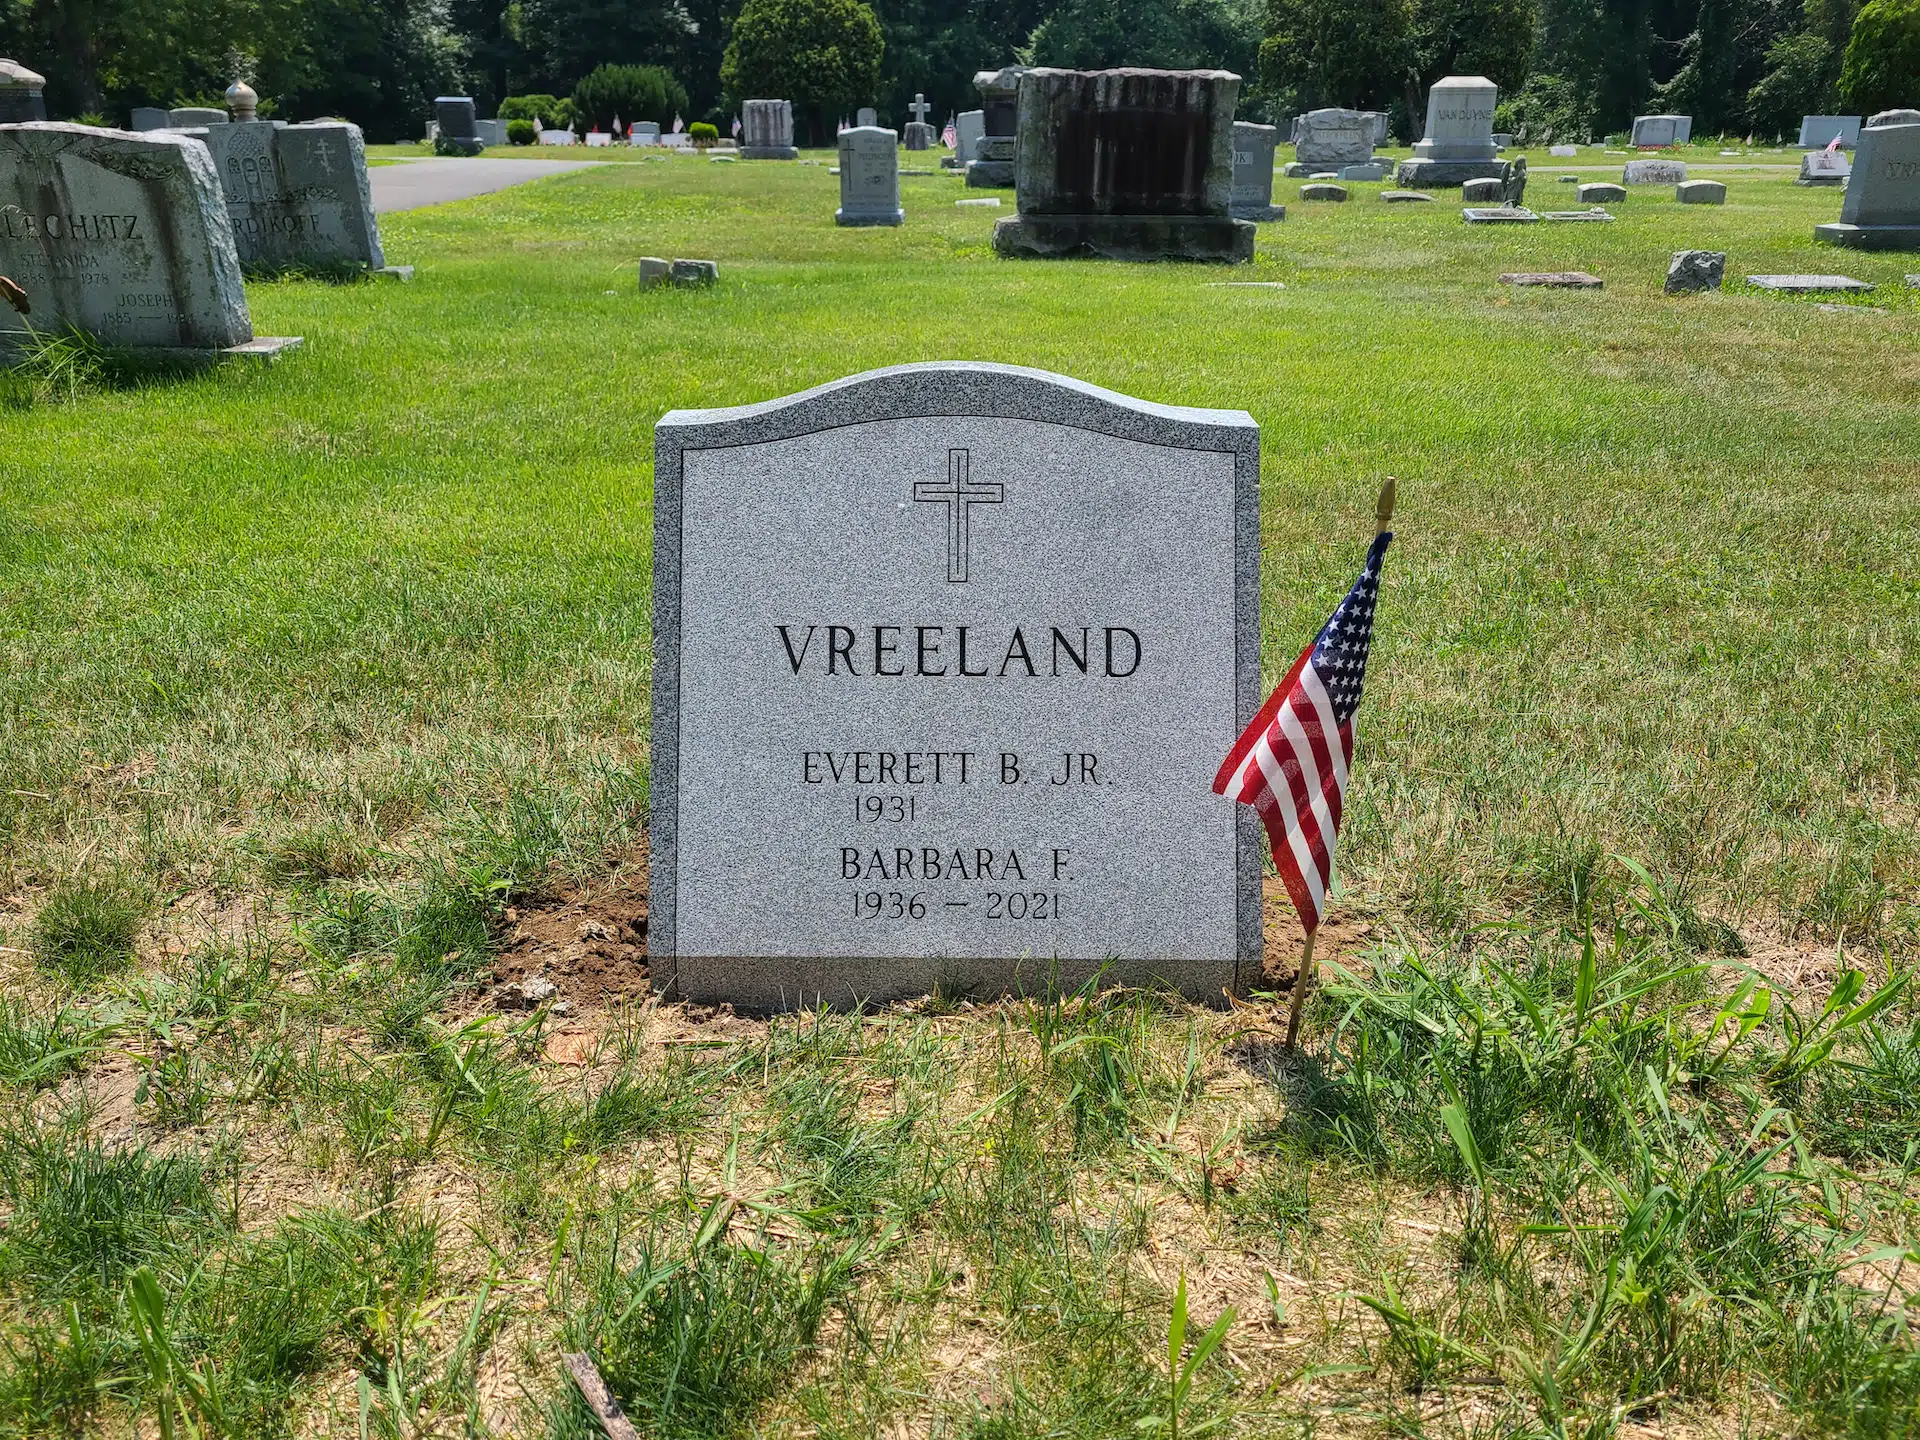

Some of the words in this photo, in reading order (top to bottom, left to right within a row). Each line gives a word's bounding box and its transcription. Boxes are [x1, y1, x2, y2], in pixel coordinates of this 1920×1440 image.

[0, 213, 143, 239] LECHITZ
[232, 214, 319, 234] RDIKOFF
[81, 272, 110, 285] 1978
[117, 293, 174, 307] JOSEPH
[102, 312, 132, 324] 1885
[775, 626, 1143, 678] VREELAND
[803, 752, 975, 785] EVERETT
[1000, 752, 1029, 785] B.
[1051, 752, 1113, 786] JR.
[854, 796, 917, 824] 1931
[840, 848, 1027, 881] BARBARA
[1052, 848, 1075, 881] F.
[853, 891, 926, 920] 1936
[986, 892, 1062, 920] 2021
